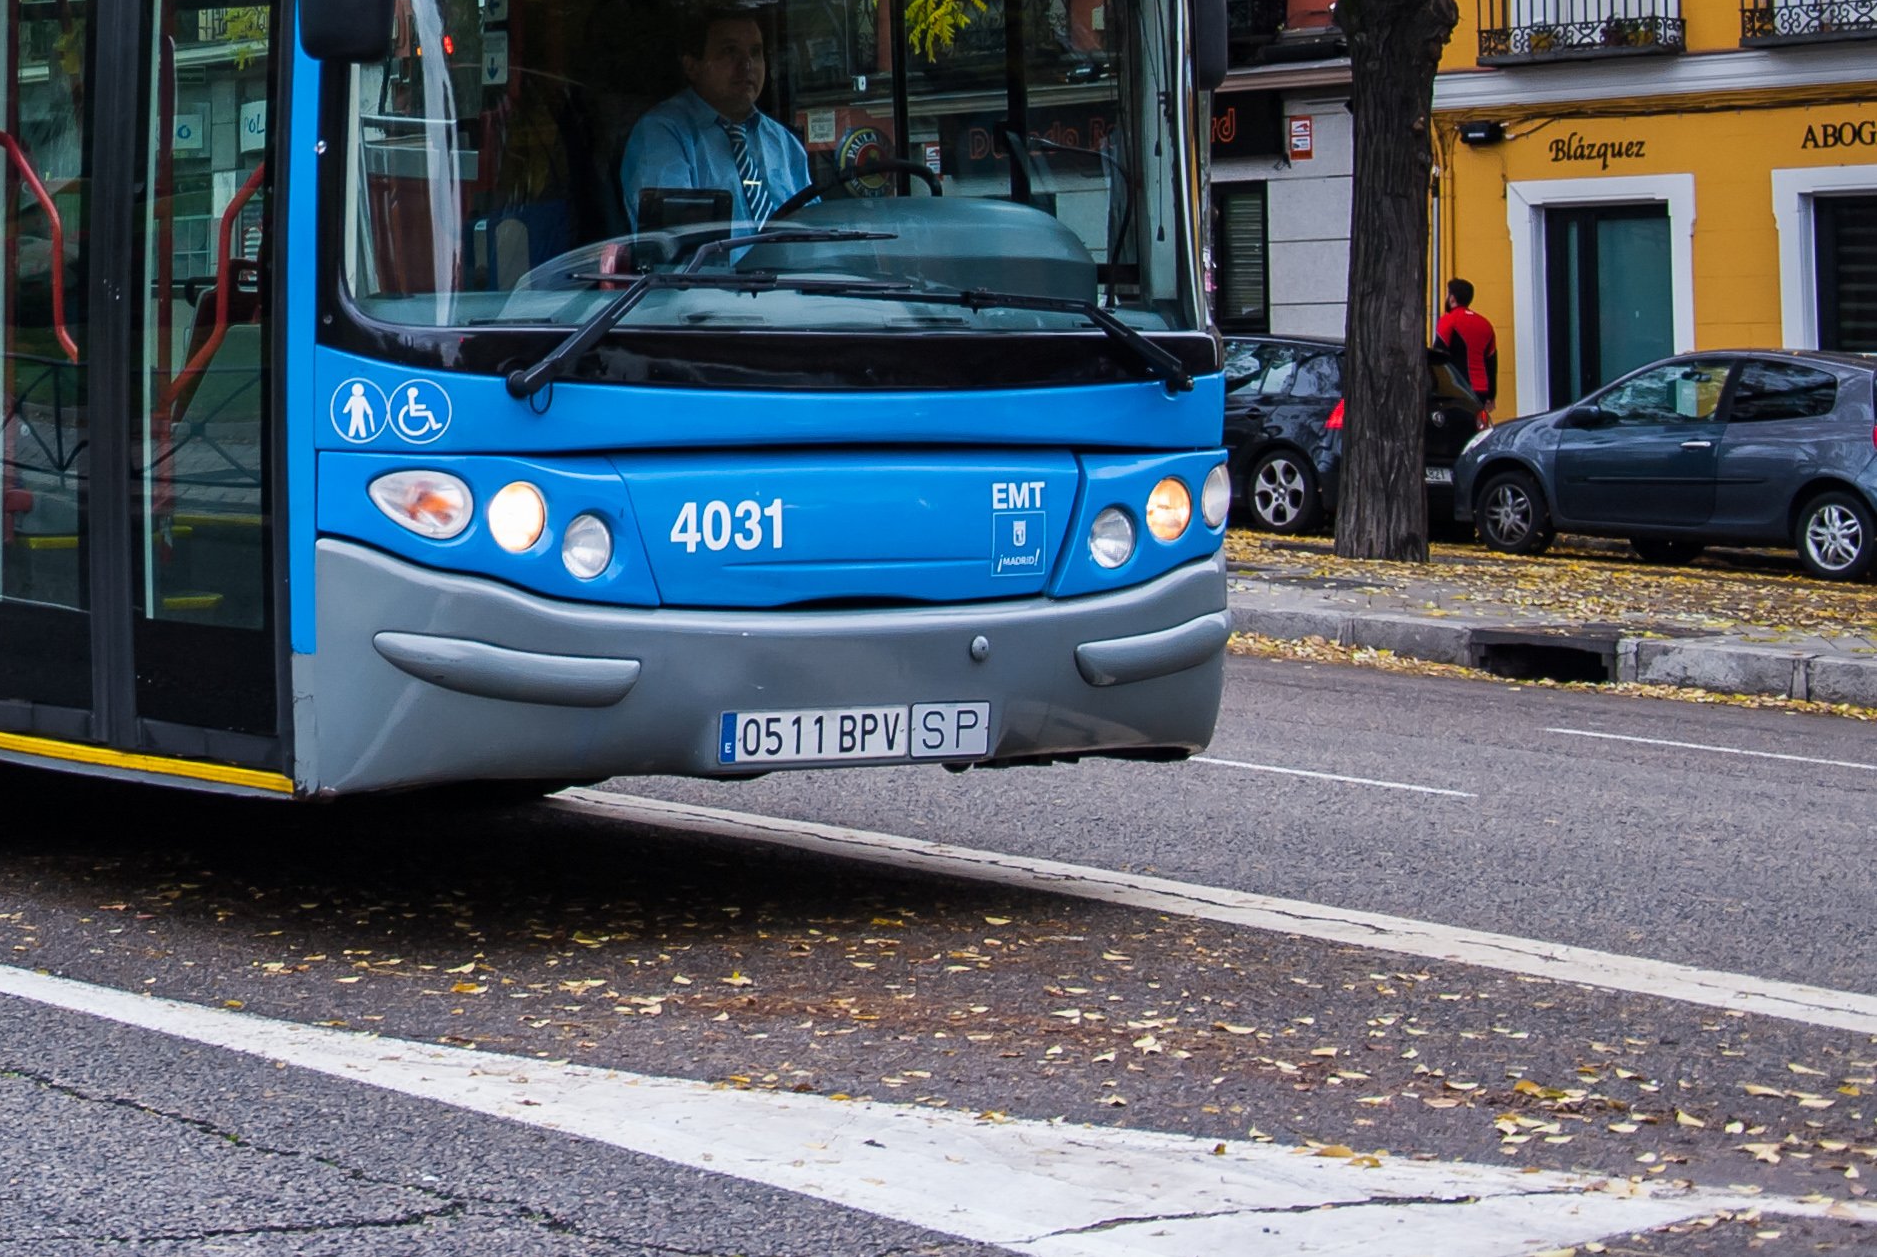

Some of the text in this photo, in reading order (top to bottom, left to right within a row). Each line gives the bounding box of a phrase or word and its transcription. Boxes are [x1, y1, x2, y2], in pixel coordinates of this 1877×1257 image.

[1549, 132, 1645, 171] Blázquez
[992, 482, 1045, 510] EMT
[670, 498, 783, 553] 4031
[724, 713, 900, 757] E 0511 BPV
[922, 709, 979, 750] SP
